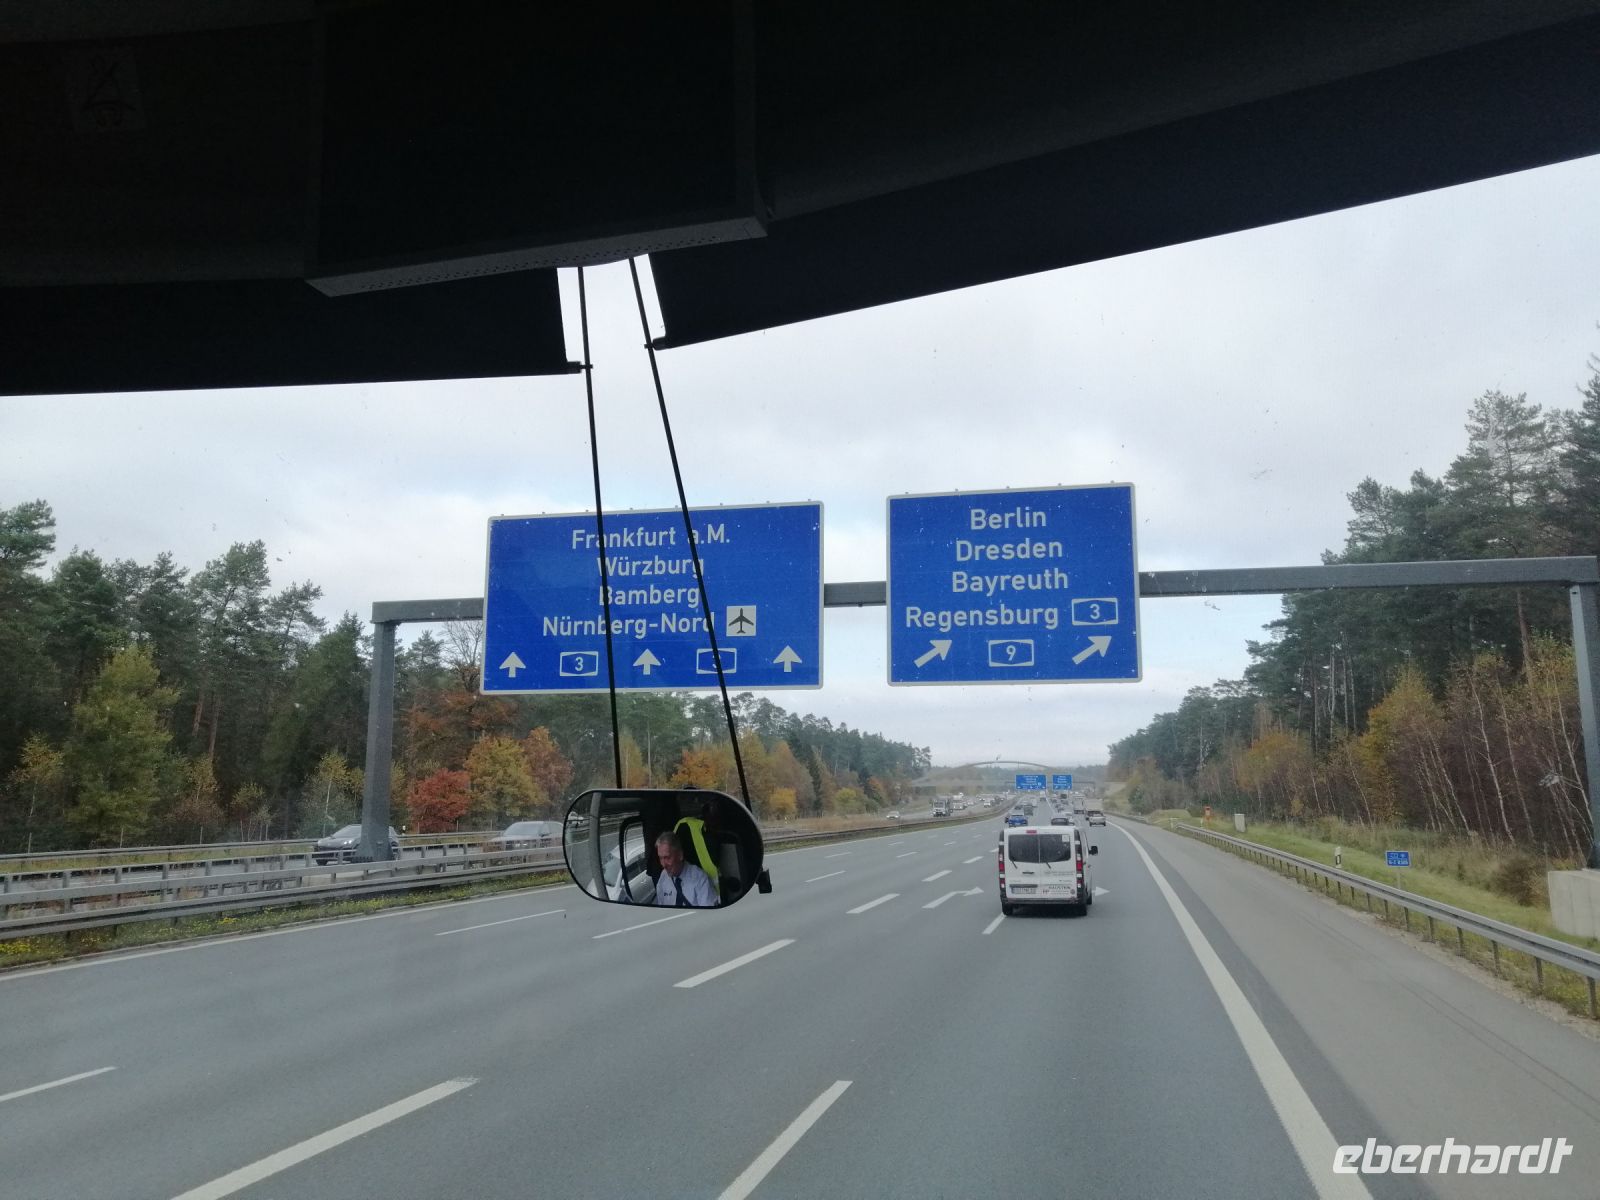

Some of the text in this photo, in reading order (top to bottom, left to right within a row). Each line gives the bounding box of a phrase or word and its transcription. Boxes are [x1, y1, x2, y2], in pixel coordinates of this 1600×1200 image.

[970, 507, 1047, 530] Berlin
[687, 523, 730, 545] a.M.
[955, 538, 1062, 562] Dresden
[596, 555, 704, 579] Würzburg
[952, 568, 1068, 596] Bayreuth
[599, 584, 700, 608] Bamberg
[905, 604, 1059, 632] Regensburg
[1089, 603, 1101, 619] 3
[543, 612, 715, 639] Nürnberg-Nord
[574, 656, 584, 672] 3
[1006, 645, 1016, 661] 9
